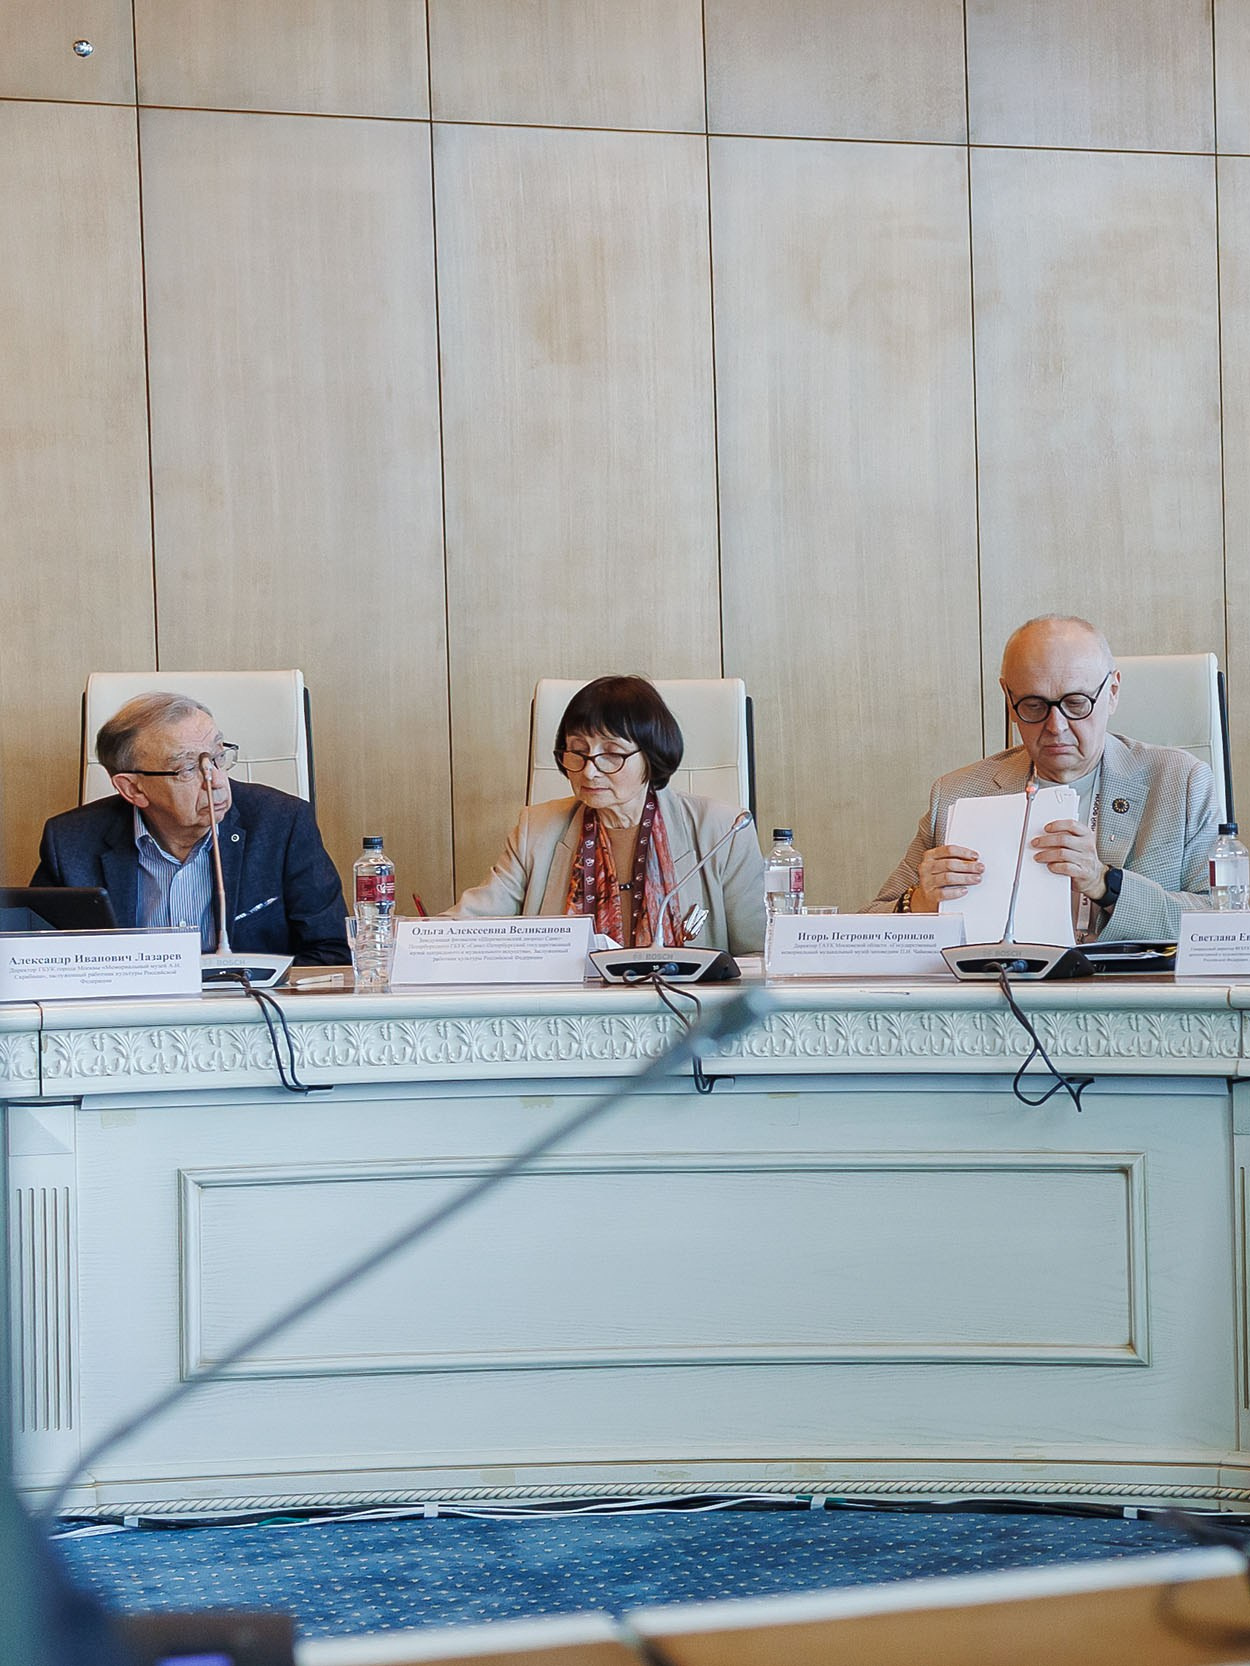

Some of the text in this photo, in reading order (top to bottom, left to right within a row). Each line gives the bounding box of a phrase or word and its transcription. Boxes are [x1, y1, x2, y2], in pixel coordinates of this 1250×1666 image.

[411, 925, 571, 936] Ольга Алексеевна Великанова
[798, 931, 935, 942] Игорь Петрович Корнилов
[1190, 932, 1236, 942] Светлана
[9, 952, 182, 966] Александр Иванович Лазарев
